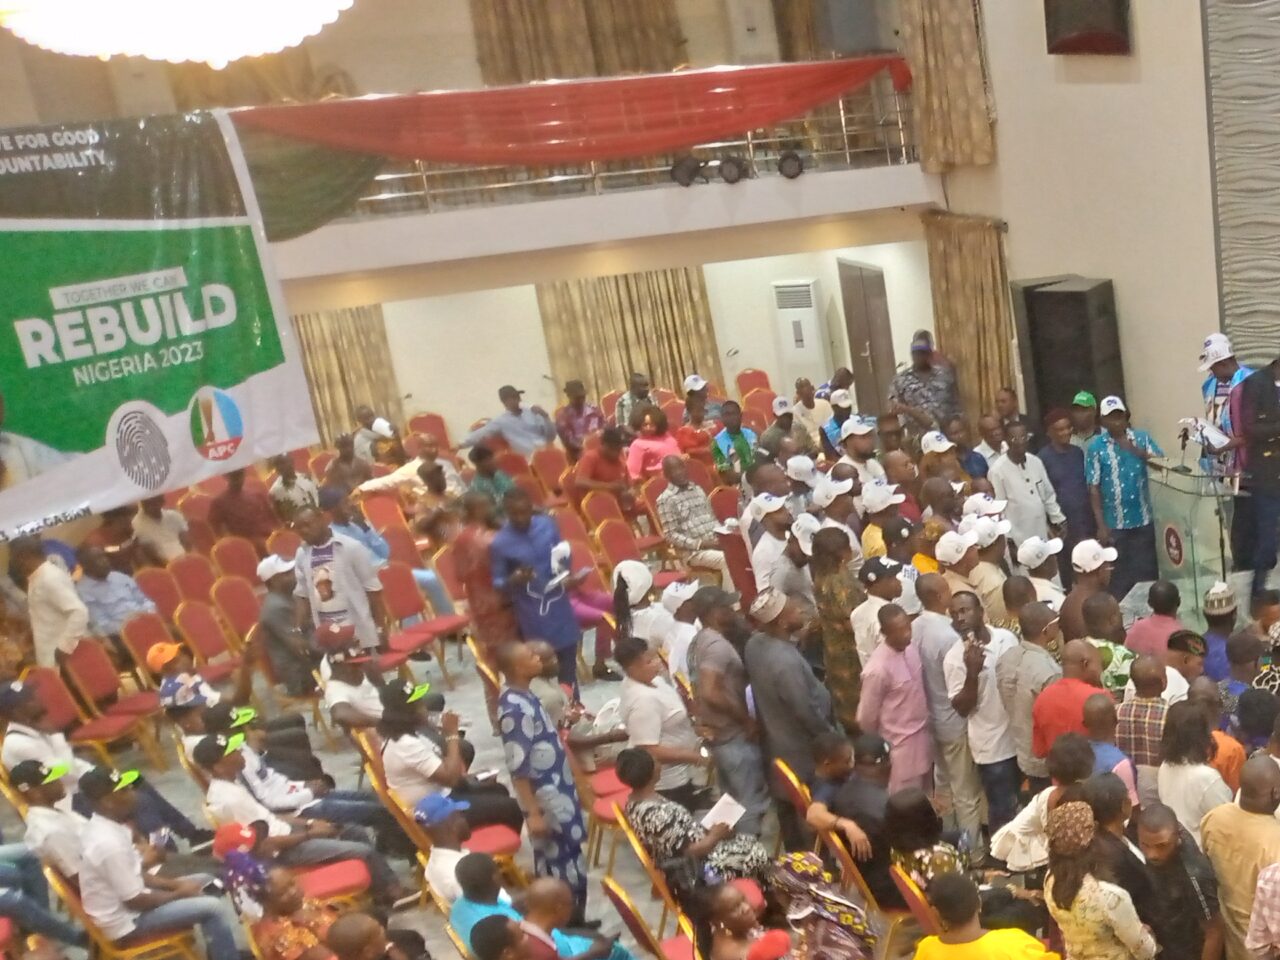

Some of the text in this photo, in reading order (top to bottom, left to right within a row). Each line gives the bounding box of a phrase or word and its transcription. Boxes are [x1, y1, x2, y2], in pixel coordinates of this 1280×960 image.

[15, 133, 50, 150] FOR
[52, 129, 100, 147] GOOD
[63, 283, 127, 305] TOGETHER
[14, 283, 238, 369] REBUILD
[72, 341, 204, 387] NIGERIA 2023
[209, 442, 235, 459] APC
